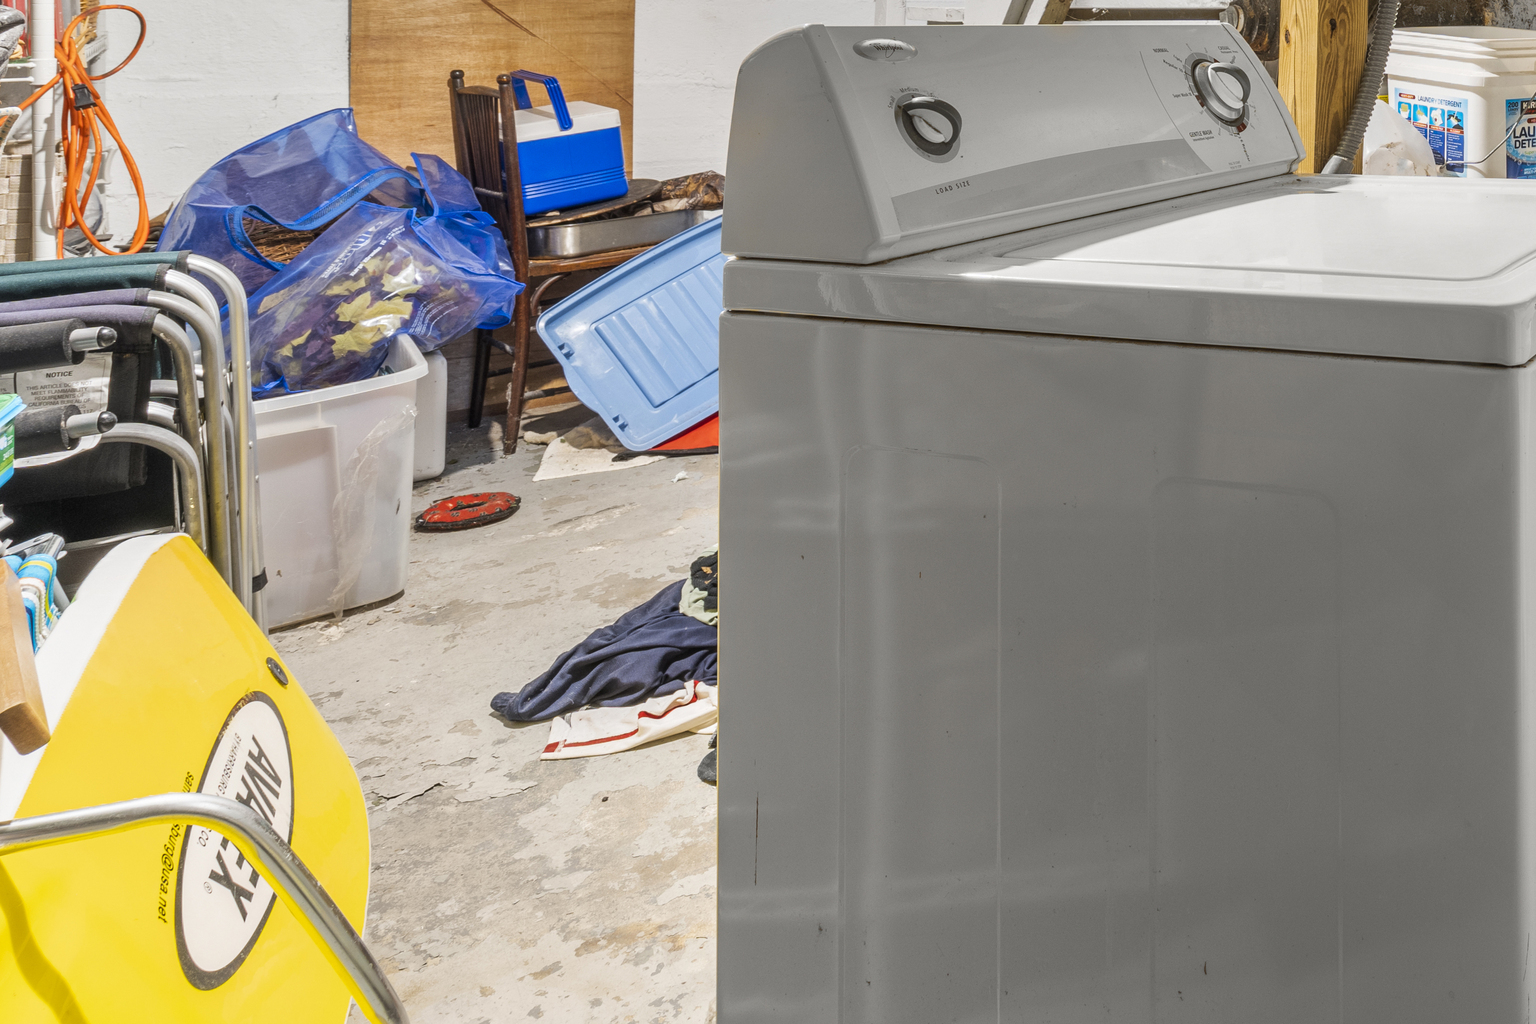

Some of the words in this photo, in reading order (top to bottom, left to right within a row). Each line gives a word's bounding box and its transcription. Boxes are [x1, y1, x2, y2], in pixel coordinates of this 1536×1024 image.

[887, 95, 896, 109] Small
[1418, 95, 1437, 104] LAUNDRY
[1438, 99, 1462, 108] DETERGENT
[935, 185, 954, 195] LOAD
[955, 180, 971, 190] SIZE
[48, 387, 88, 395] FLAMMABILITY
[217, 743, 239, 794] HARRISBURG
[209, 734, 282, 922] AVAEX
